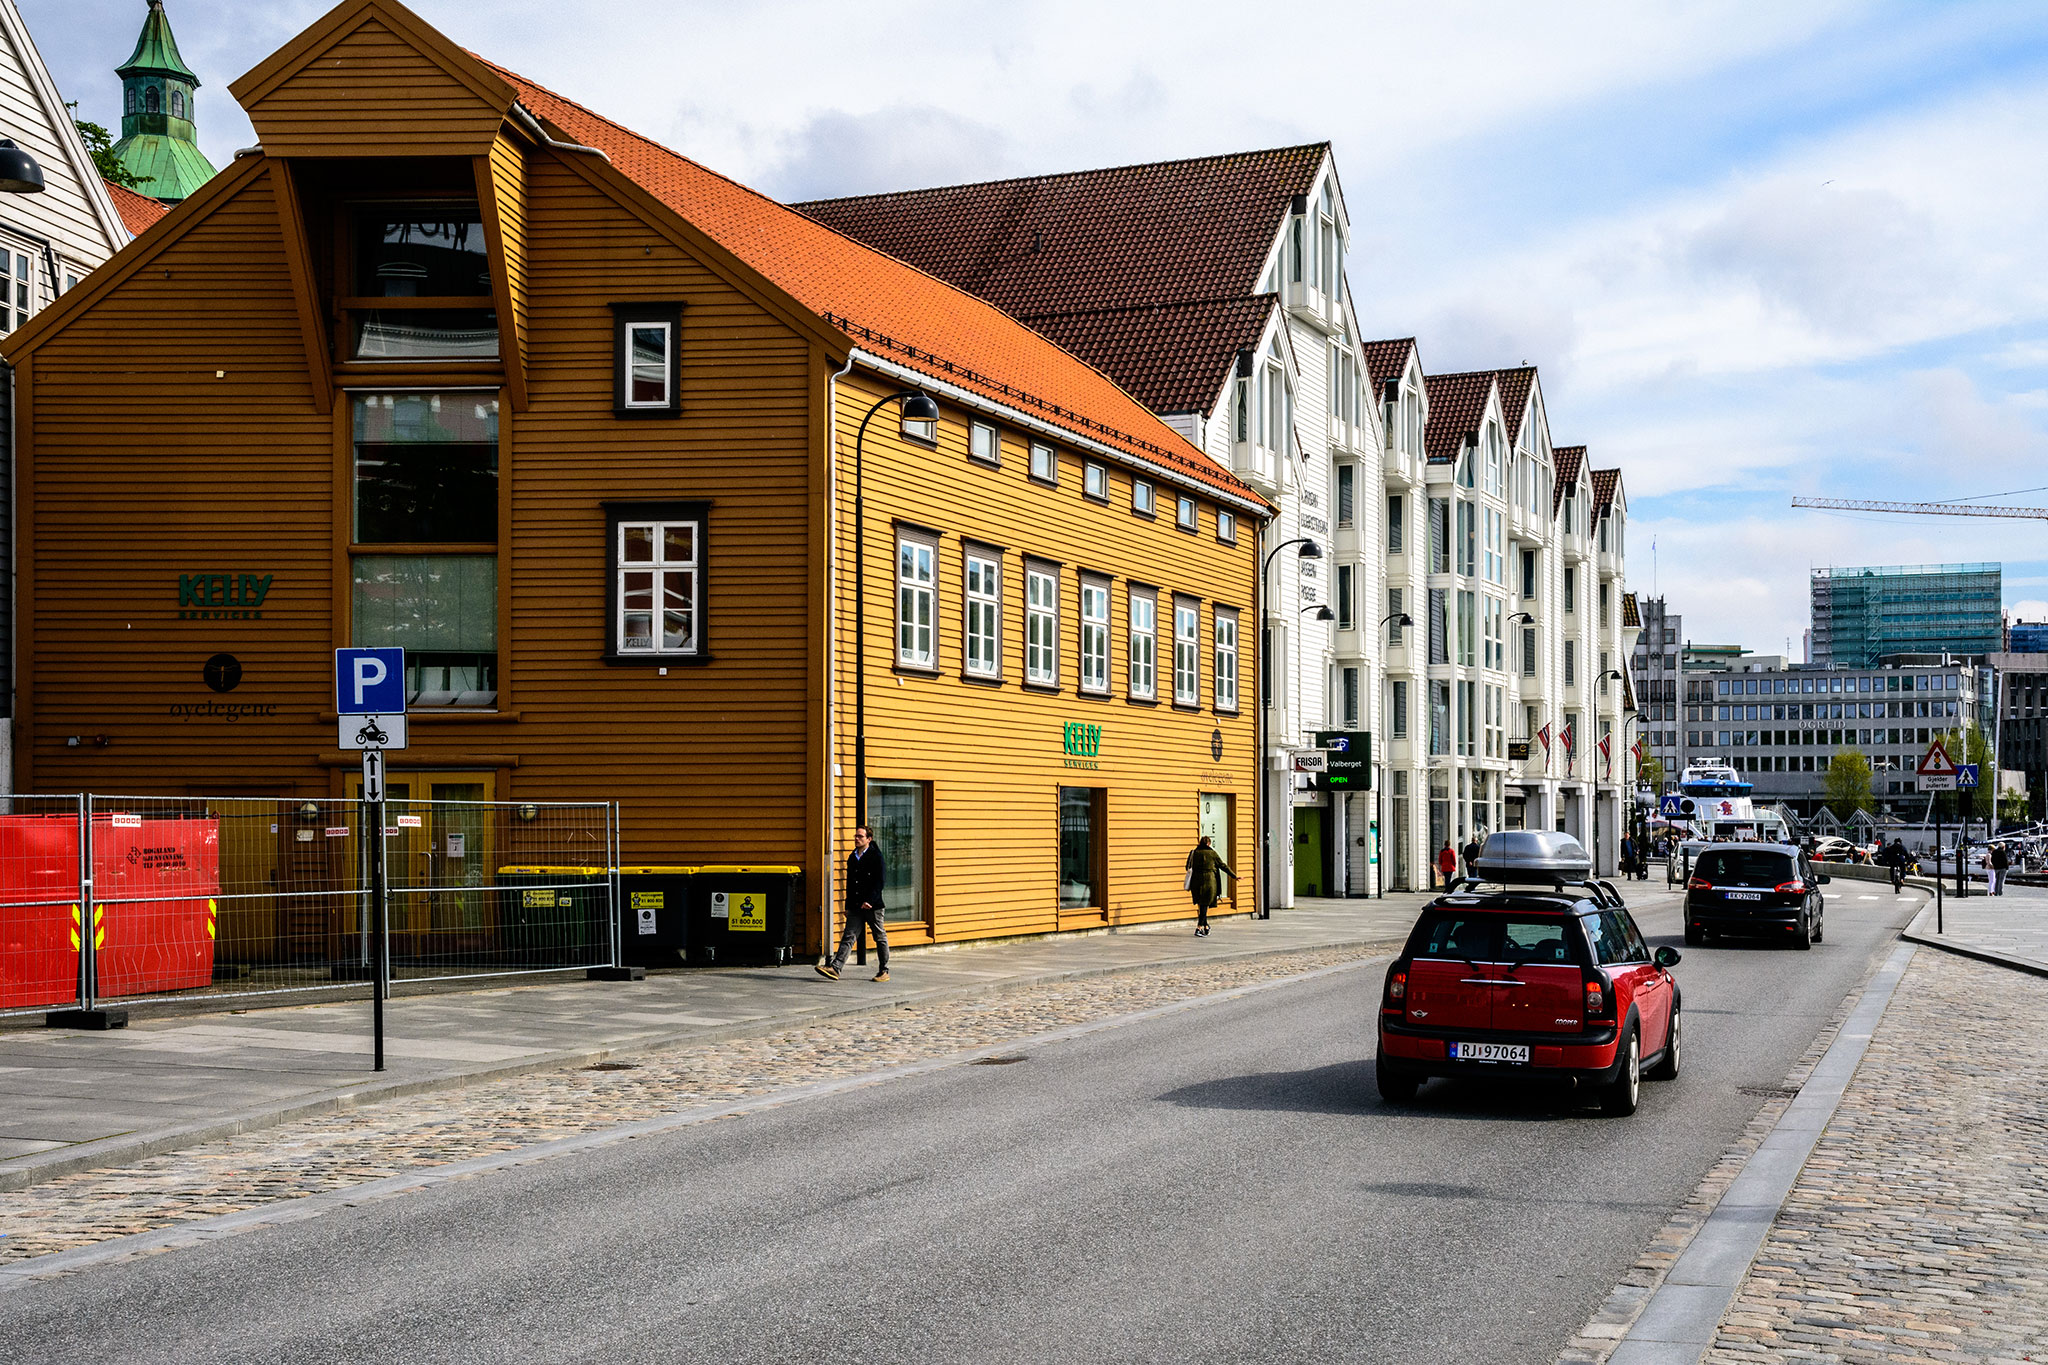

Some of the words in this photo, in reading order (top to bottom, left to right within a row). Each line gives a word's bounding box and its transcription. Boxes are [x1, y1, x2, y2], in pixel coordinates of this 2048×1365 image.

[179, 574, 273, 607] KELLY
[178, 611, 262, 620] SERVICES
[354, 657, 387, 705] P
[1064, 721, 1102, 757] KELLY
[1064, 759, 1099, 770] SERVICES
[1329, 760, 1362, 769] Valberget
[1329, 776, 1348, 784] OPEN
[1925, 781, 1950, 789] pullerter
[143, 847, 176, 855] ROGALAND
[1462, 1044, 1477, 1057] RJ
[1484, 1045, 1527, 1060] 97064
